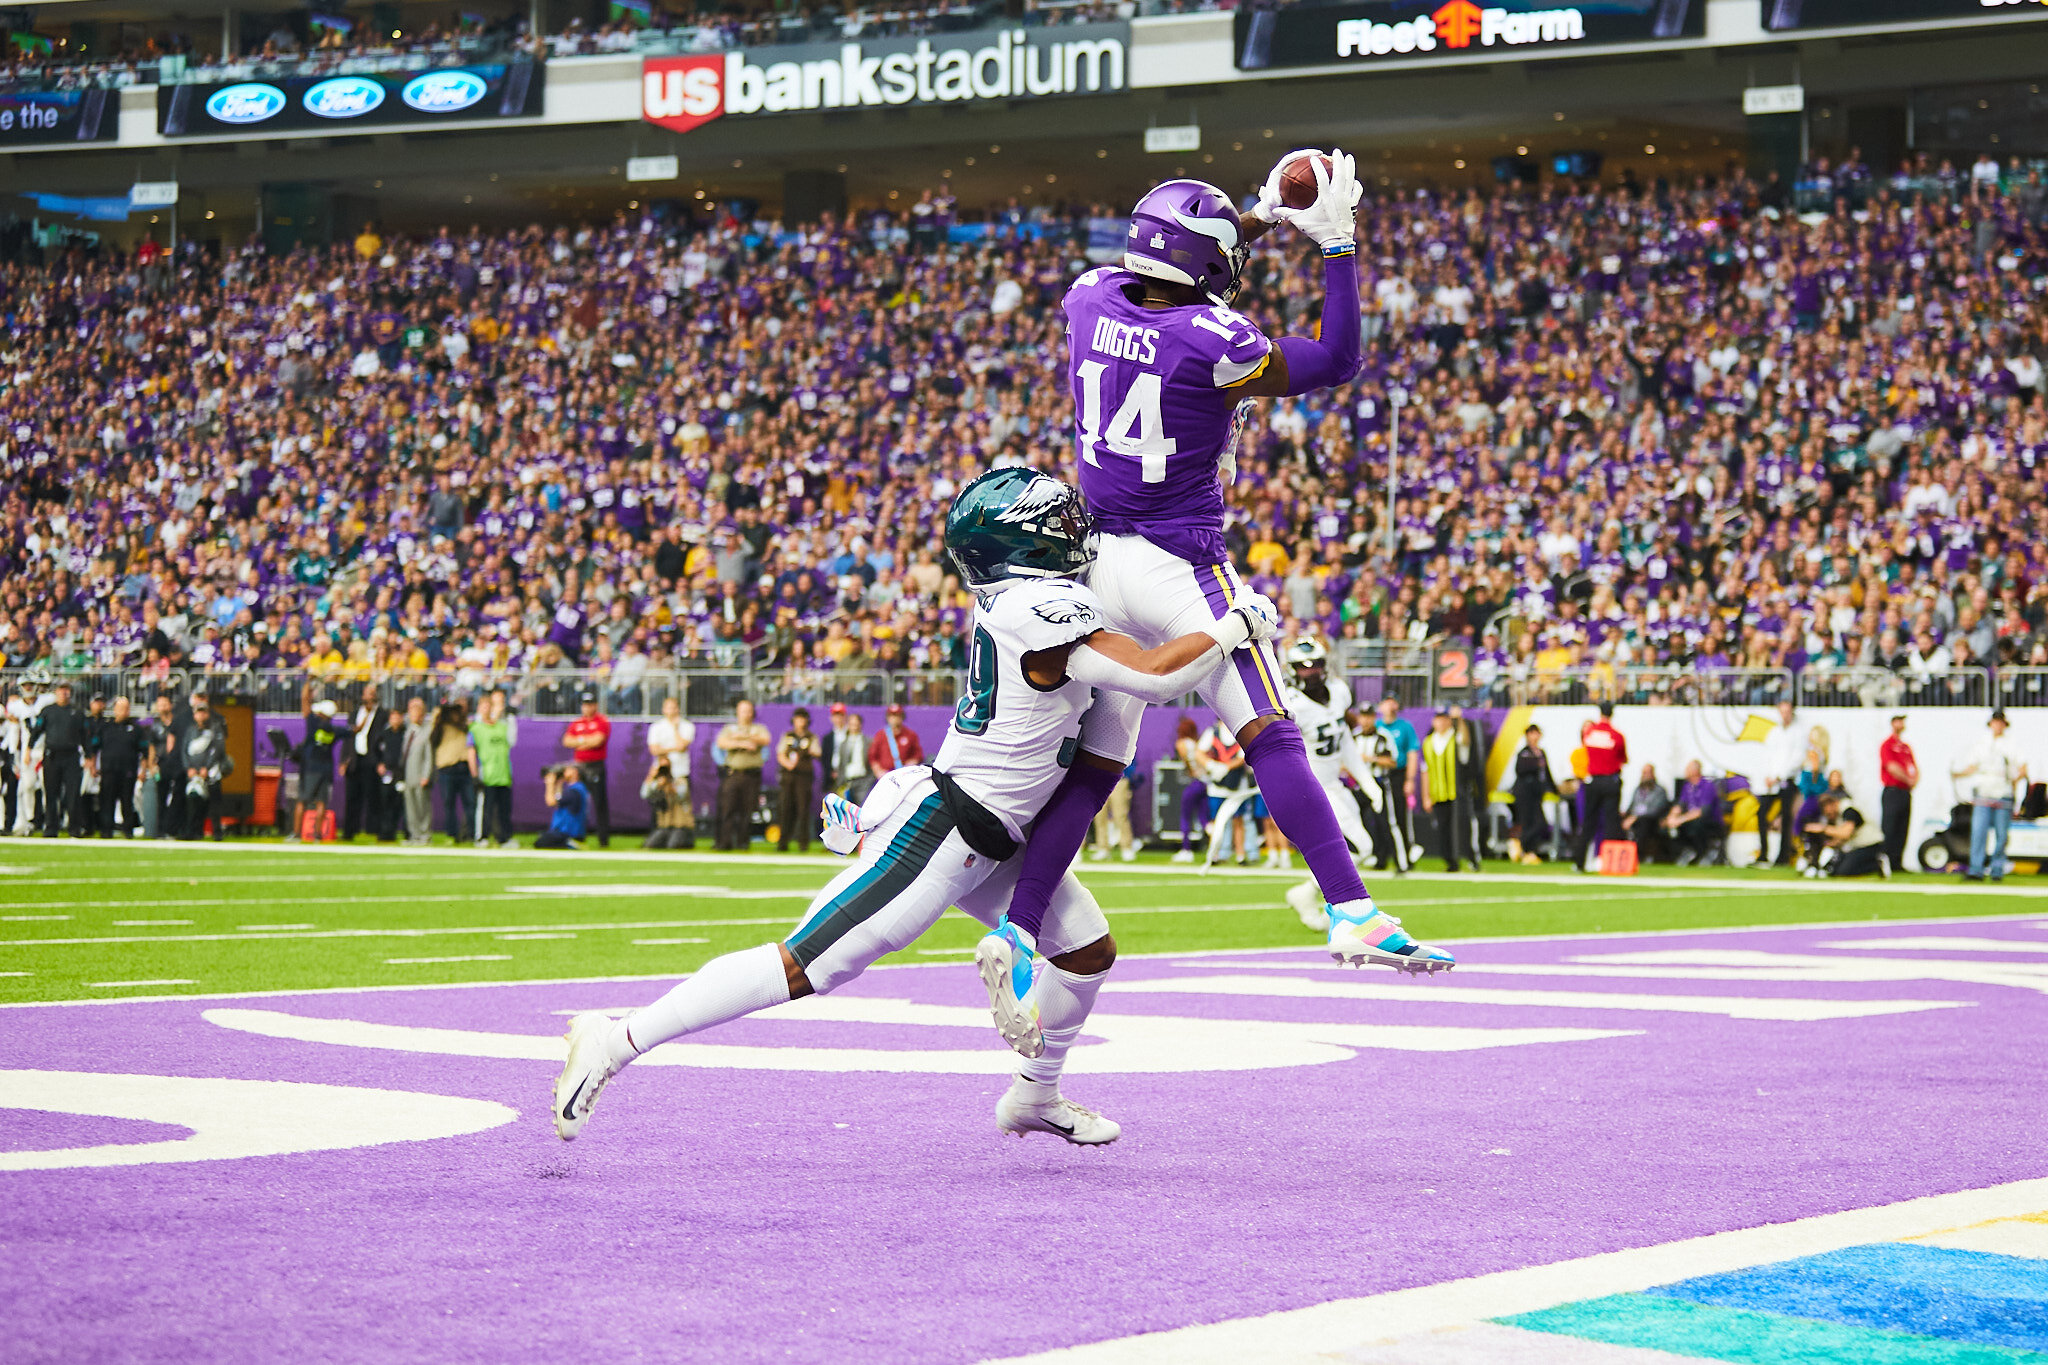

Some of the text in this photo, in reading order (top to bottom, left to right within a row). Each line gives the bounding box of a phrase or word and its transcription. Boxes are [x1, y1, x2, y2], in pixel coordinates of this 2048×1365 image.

[1337, 8, 1583, 57] Fleet Farm
[20, 101, 58, 129] the
[644, 67, 720, 118] us
[1092, 316, 1159, 365] DIGGS
[1191, 306, 1250, 342] 14
[1076, 358, 1177, 483] 14
[1439, 651, 1468, 687] 2
